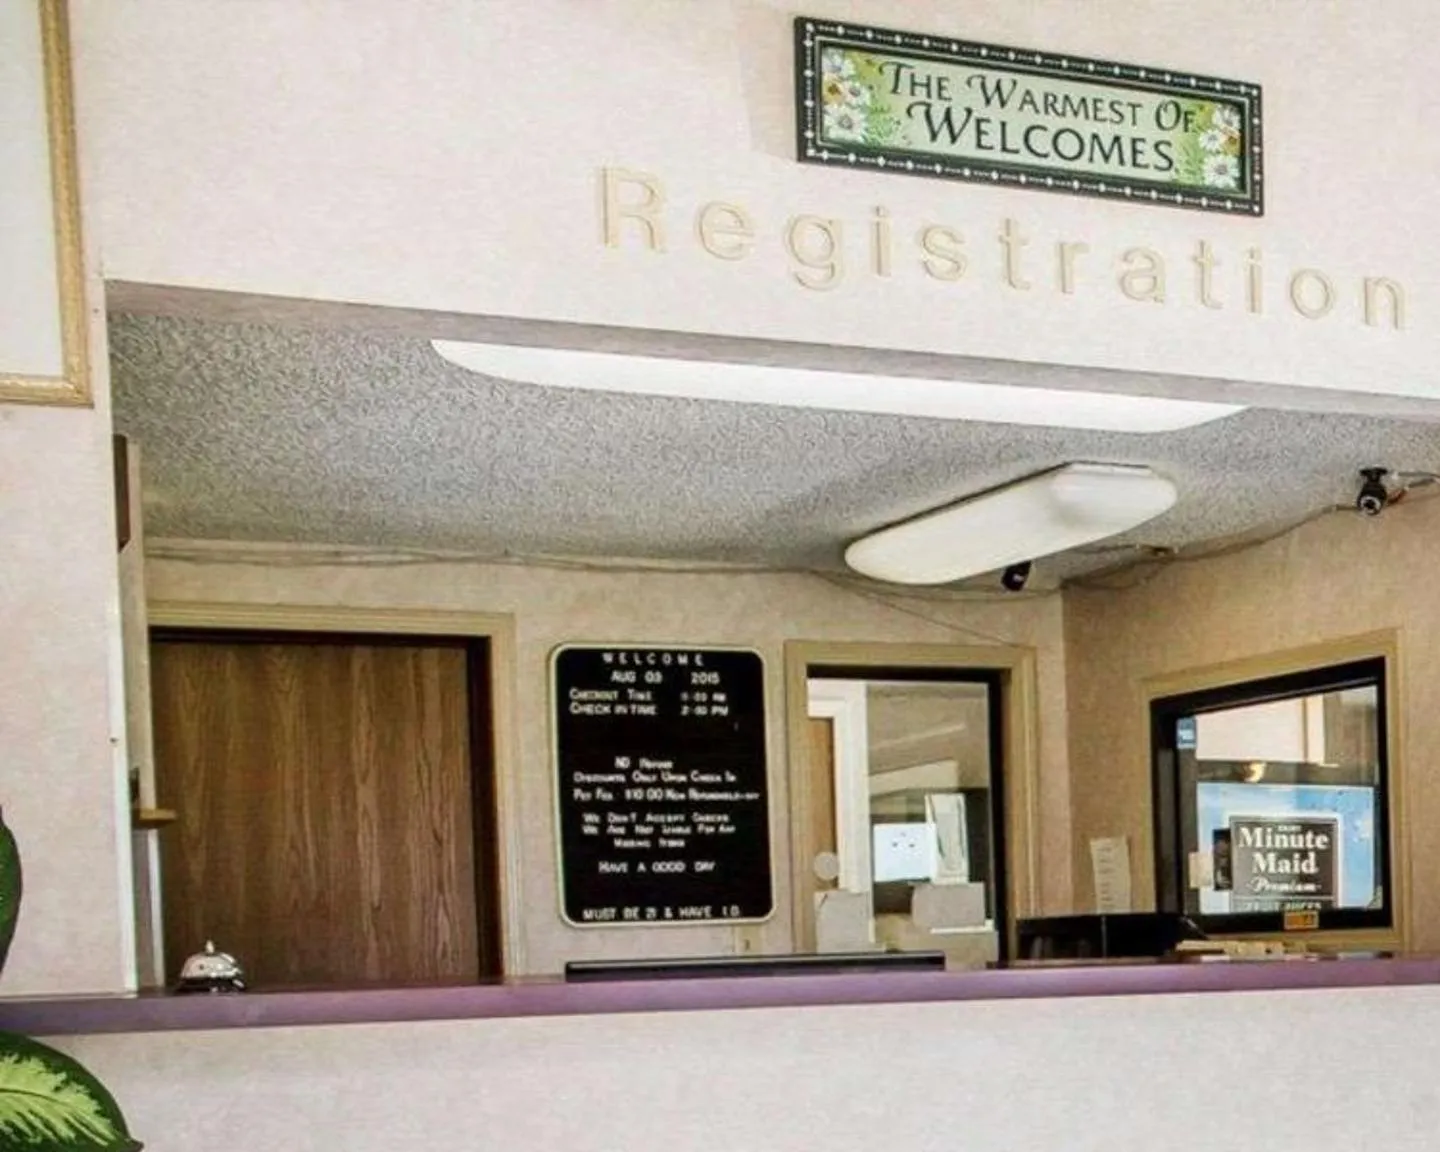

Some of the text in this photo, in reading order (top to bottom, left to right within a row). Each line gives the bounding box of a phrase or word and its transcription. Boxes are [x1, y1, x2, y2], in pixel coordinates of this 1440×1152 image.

[878, 60, 951, 101] THE
[966, 74, 1145, 127] WARMEST
[907, 100, 1176, 172] WELCOMES
[600, 166, 1409, 331] Registration
[602, 652, 703, 667] WELCOME
[569, 701, 612, 715] CHECK
[1238, 826, 1330, 849] Minute
[598, 861, 628, 873] HAVE
[637, 862, 647, 872] A
[1251, 851, 1319, 875] Maid
